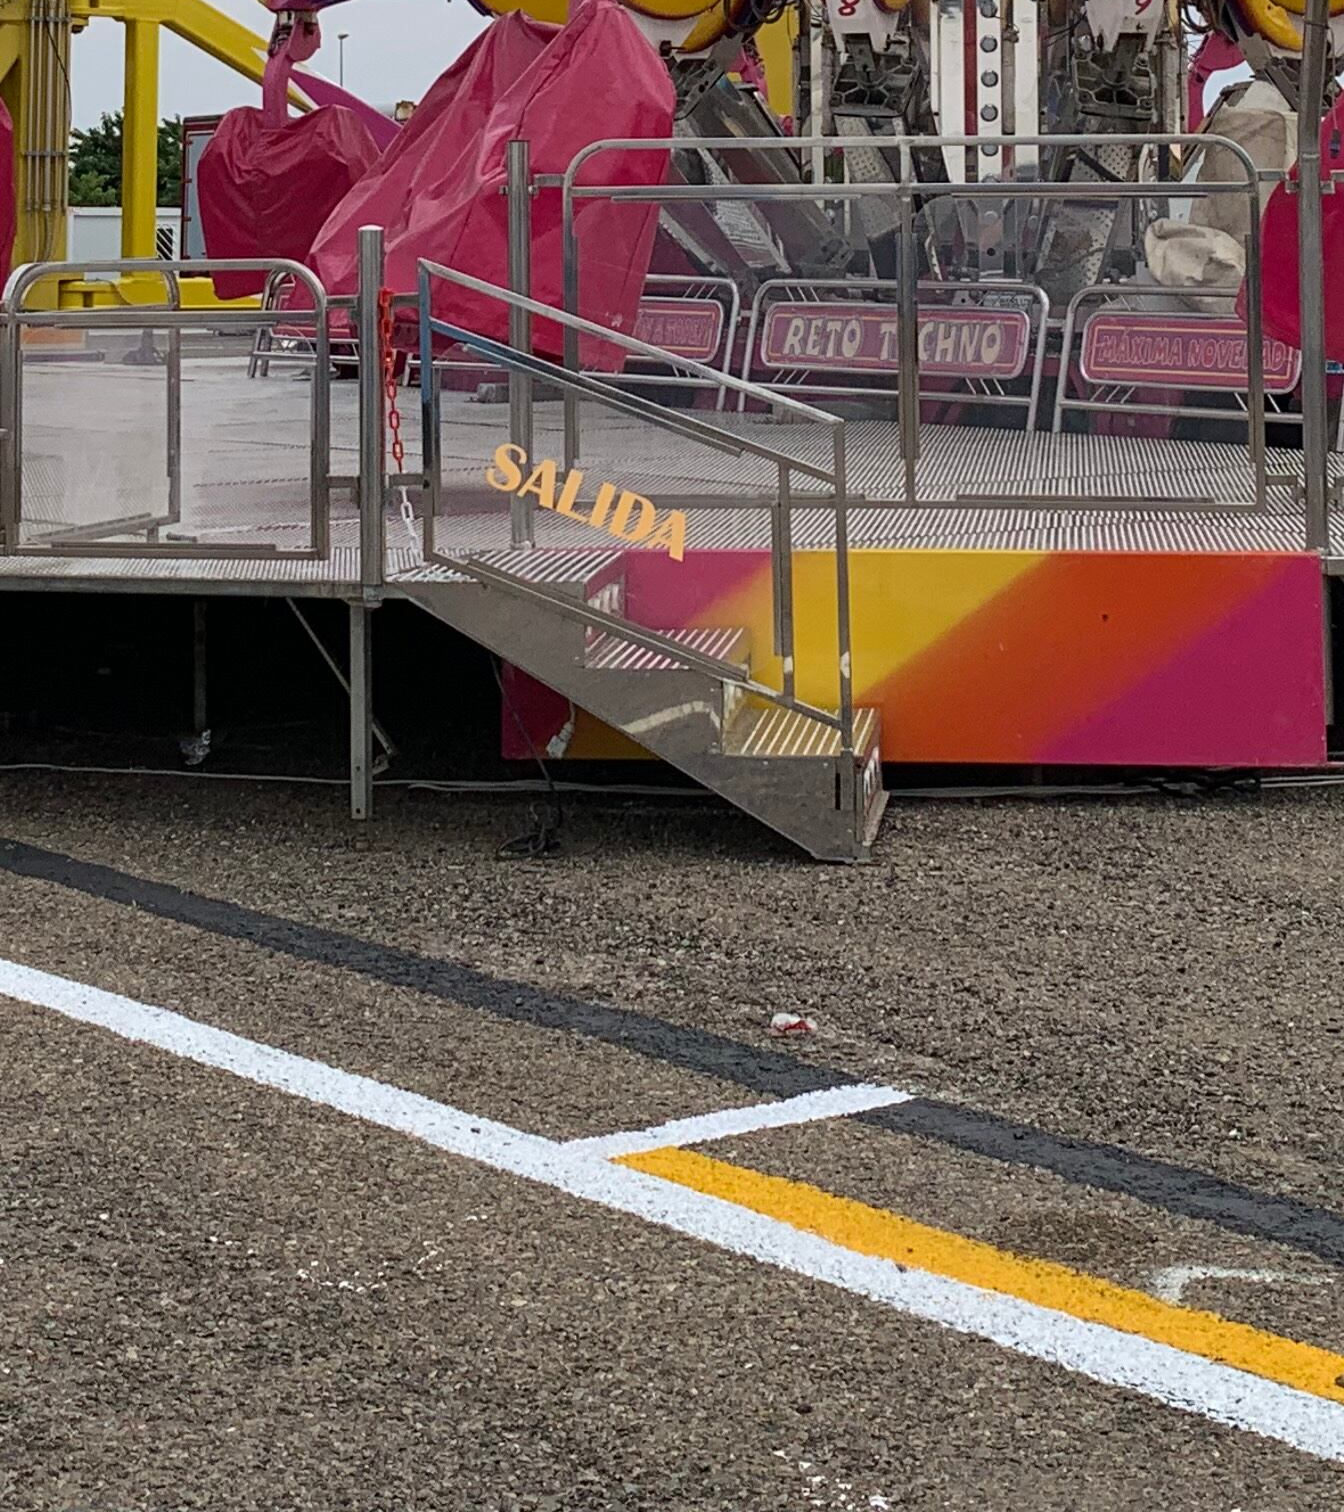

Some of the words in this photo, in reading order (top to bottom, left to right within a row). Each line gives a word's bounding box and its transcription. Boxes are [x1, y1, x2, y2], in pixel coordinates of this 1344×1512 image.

[782, 317, 862, 358] RETO
[879, 320, 1003, 365] TCHNO
[486, 443, 687, 563] SALIDA
